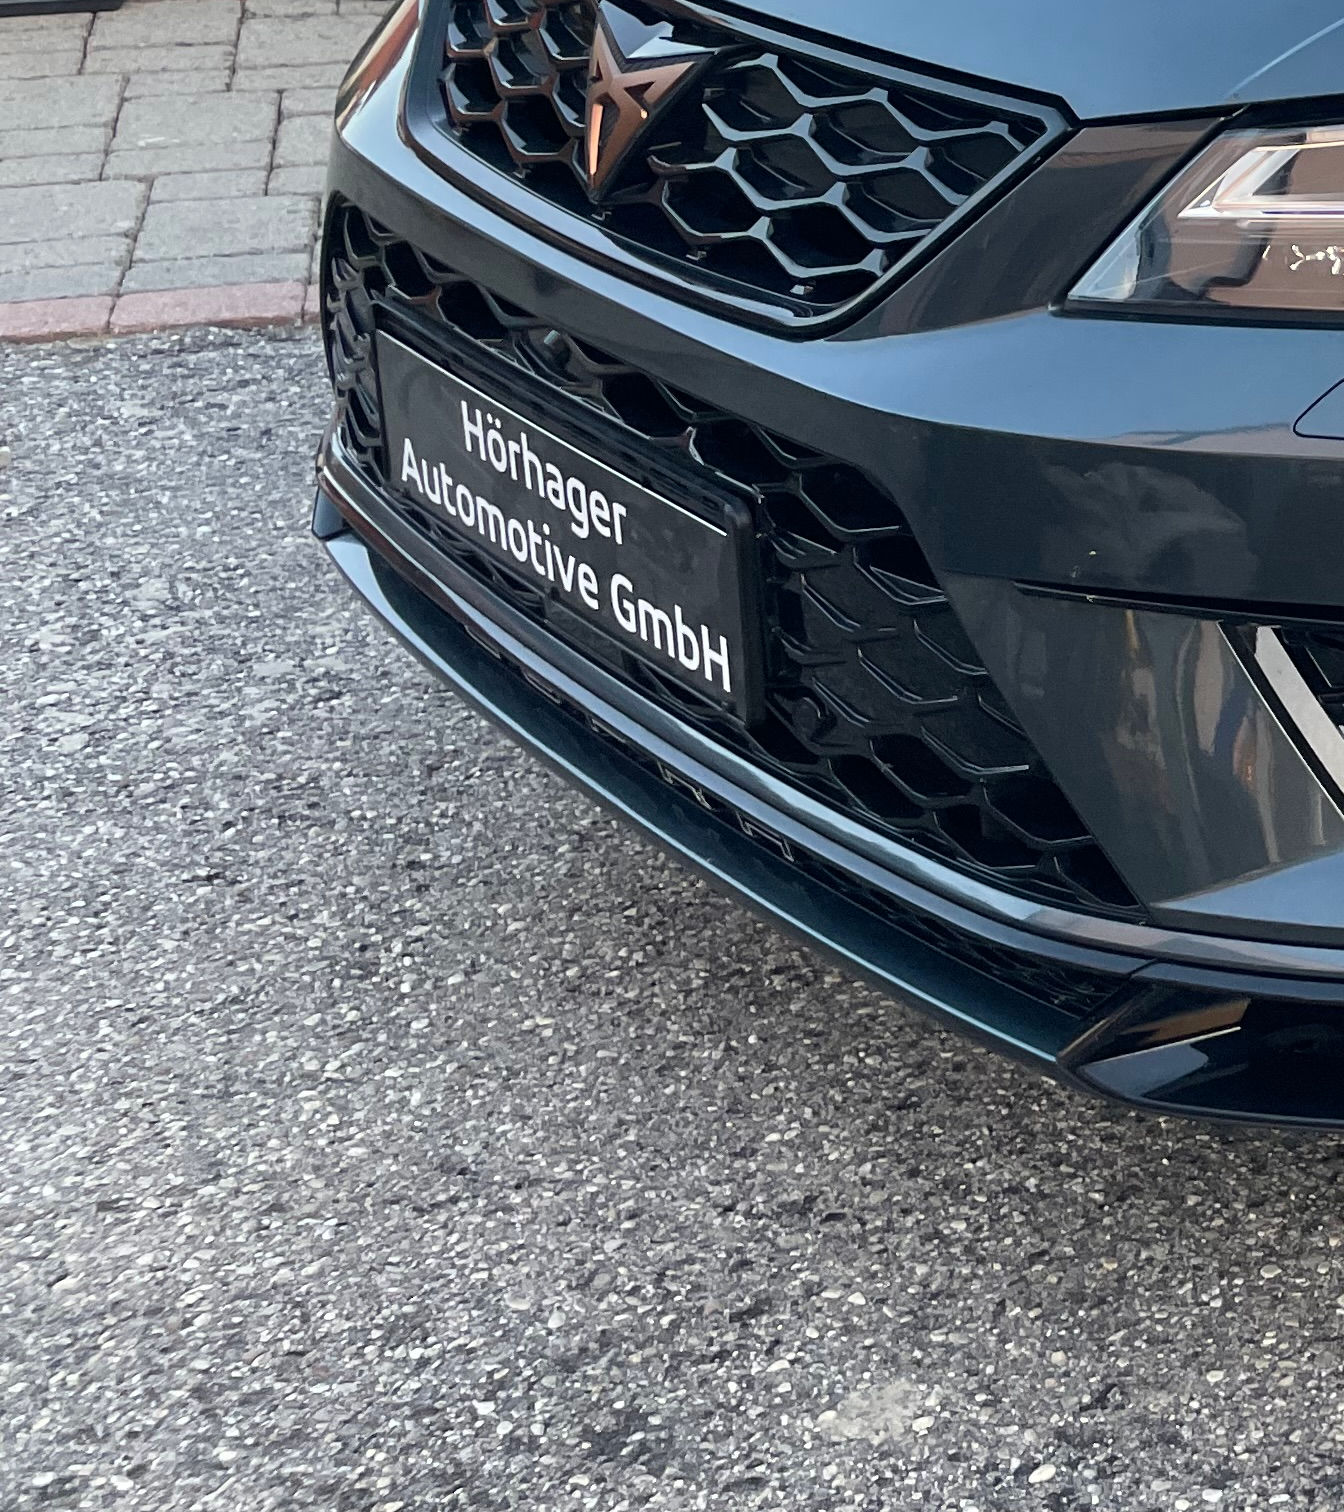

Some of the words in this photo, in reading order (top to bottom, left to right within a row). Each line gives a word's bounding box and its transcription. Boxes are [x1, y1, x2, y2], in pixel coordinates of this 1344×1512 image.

[401, 437, 599, 610] Automotive
[610, 573, 731, 693] GmbH
[460, 399, 627, 545] Hörhager
